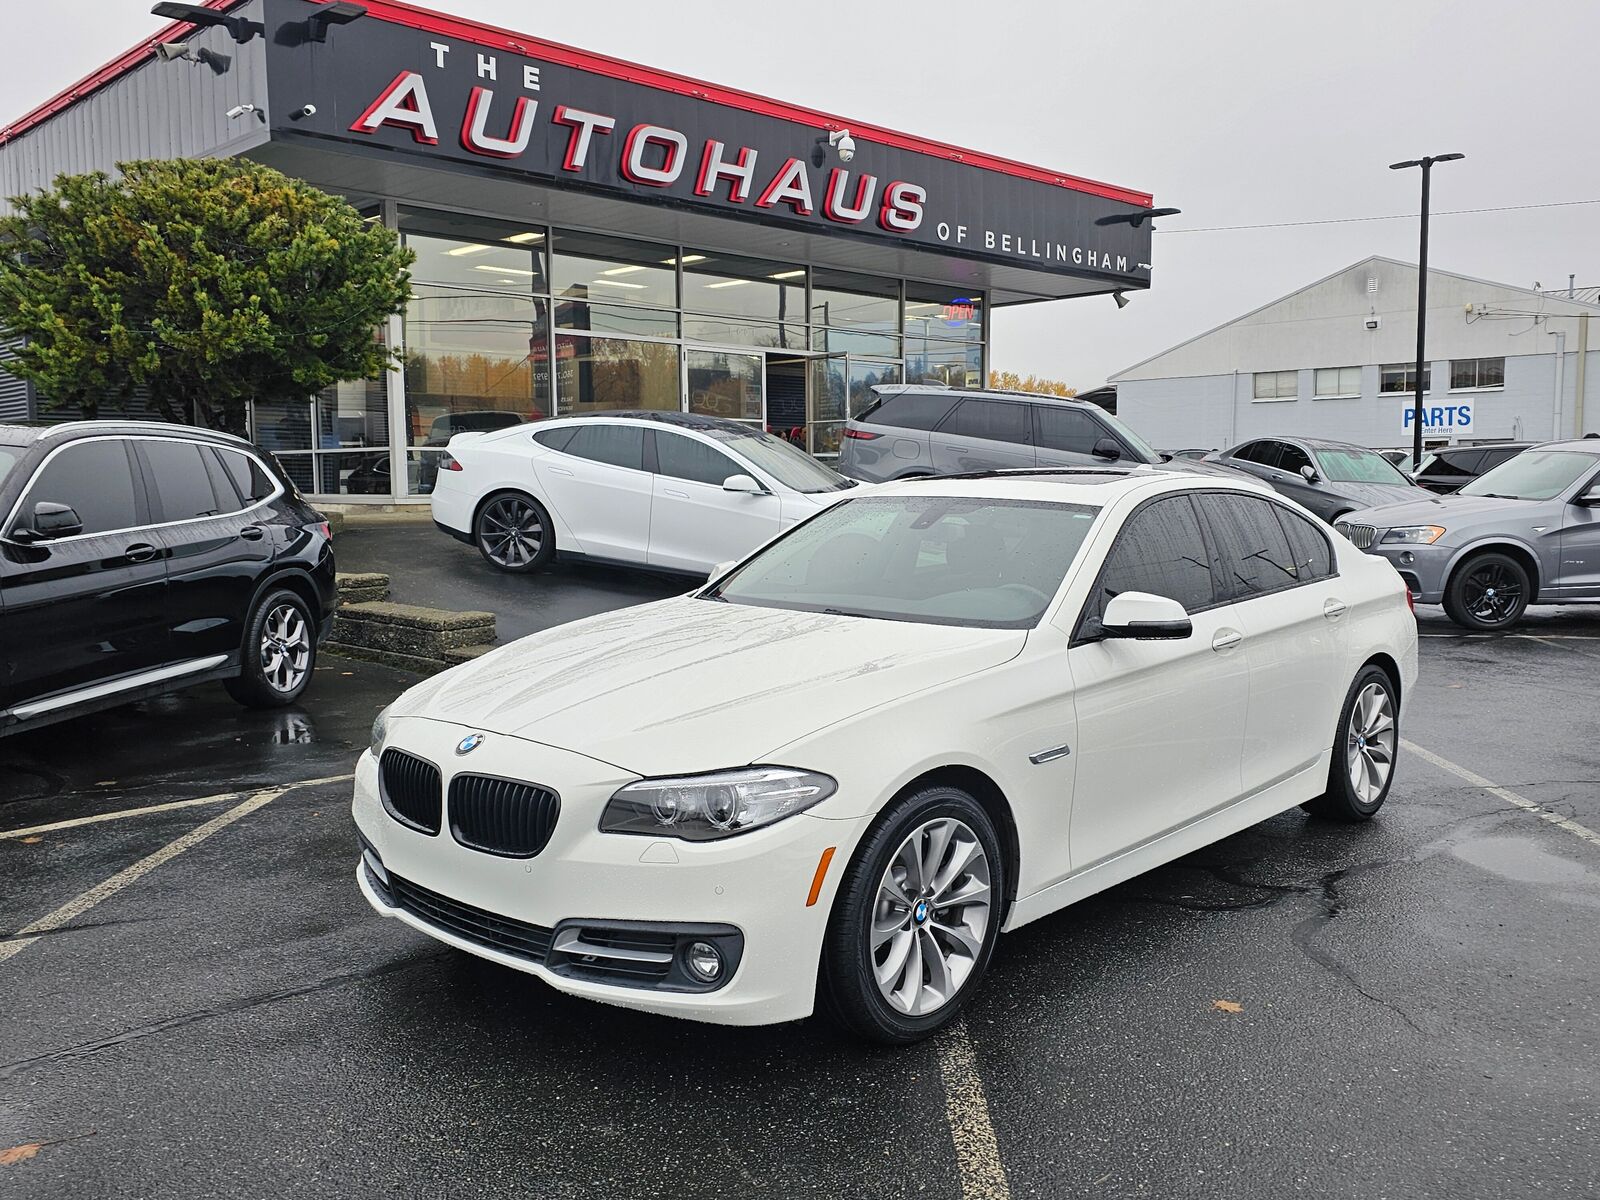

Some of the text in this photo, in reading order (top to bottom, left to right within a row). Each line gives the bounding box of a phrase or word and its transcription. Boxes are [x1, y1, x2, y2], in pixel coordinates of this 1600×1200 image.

[430, 42, 540, 90] THE
[348, 70, 1127, 272] AUTOHAUS OF BELLINGHAM
[943, 304, 974, 320] OPEN
[1404, 405, 1471, 428] PARTS
